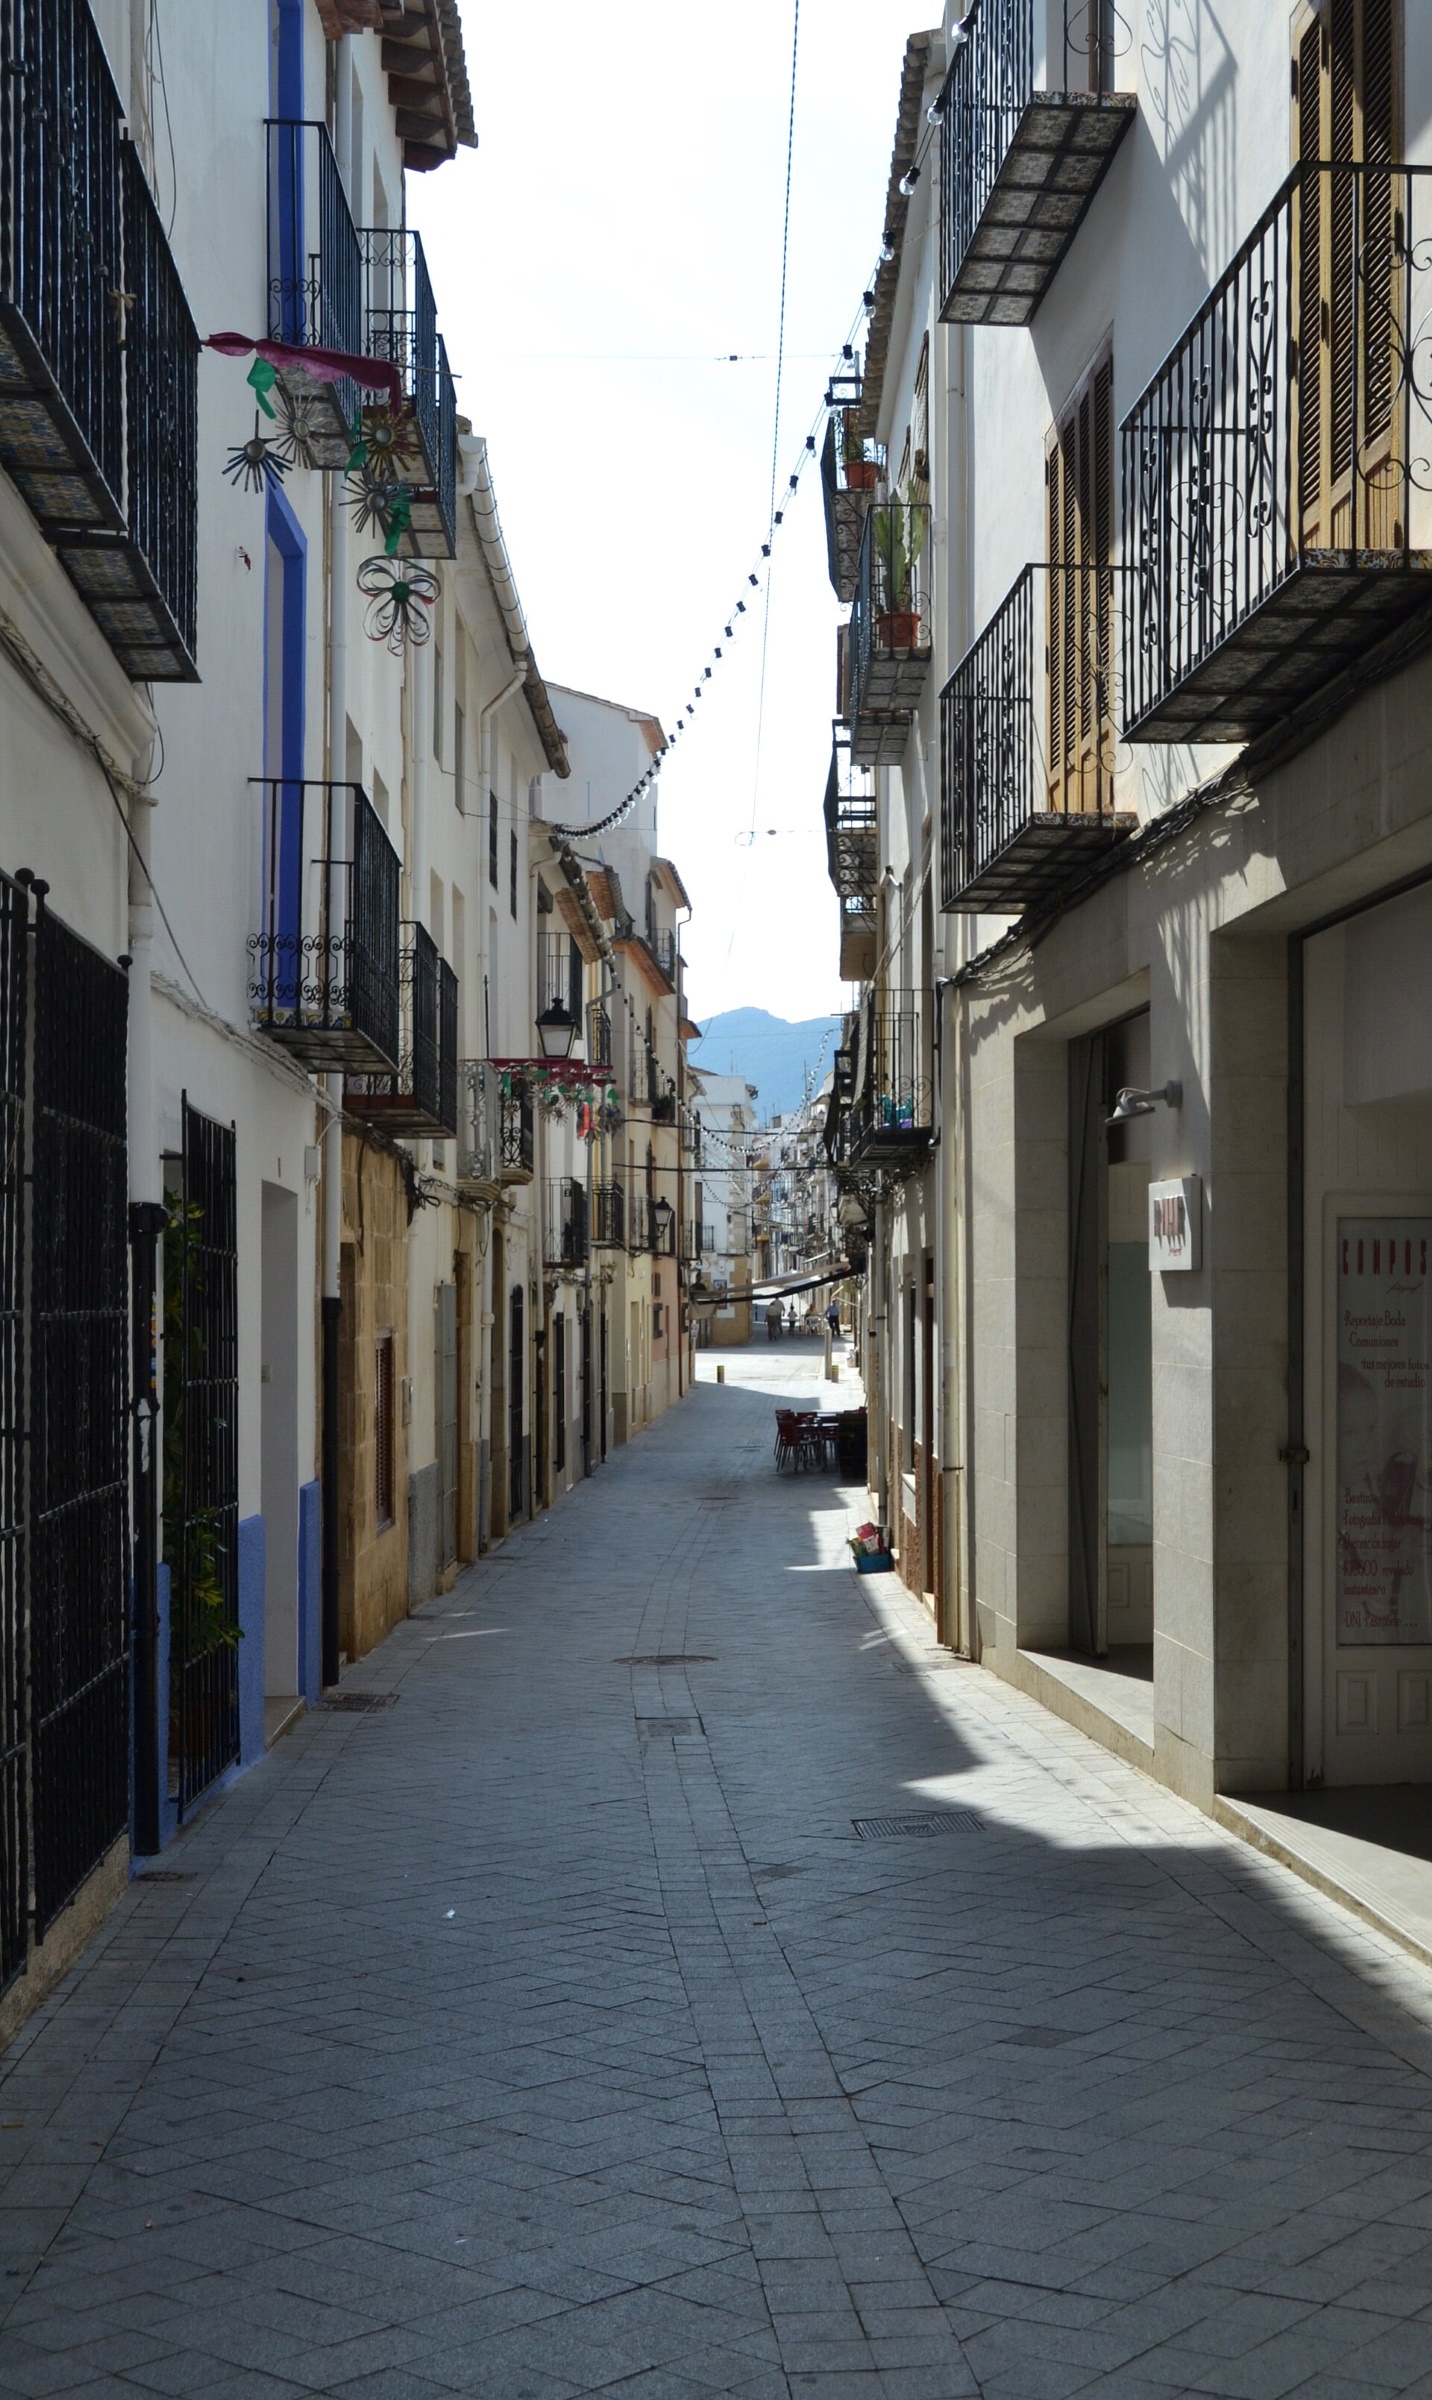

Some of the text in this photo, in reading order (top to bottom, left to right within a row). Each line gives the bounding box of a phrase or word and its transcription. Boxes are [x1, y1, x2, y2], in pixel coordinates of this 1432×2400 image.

[1342, 1239, 1427, 1276] CAMPOS
[1344, 1310, 1406, 1329] Reportaje Boda
[1349, 1331, 1399, 1348] Comuniones
[1361, 1357, 1430, 1372] tus mejores fotos
[1384, 1371, 1425, 1388] de estudio
[1381, 1532, 1401, 1553] hogar
[1382, 1560, 1415, 1576] revelado
[1344, 1611, 1361, 1628] DNI
